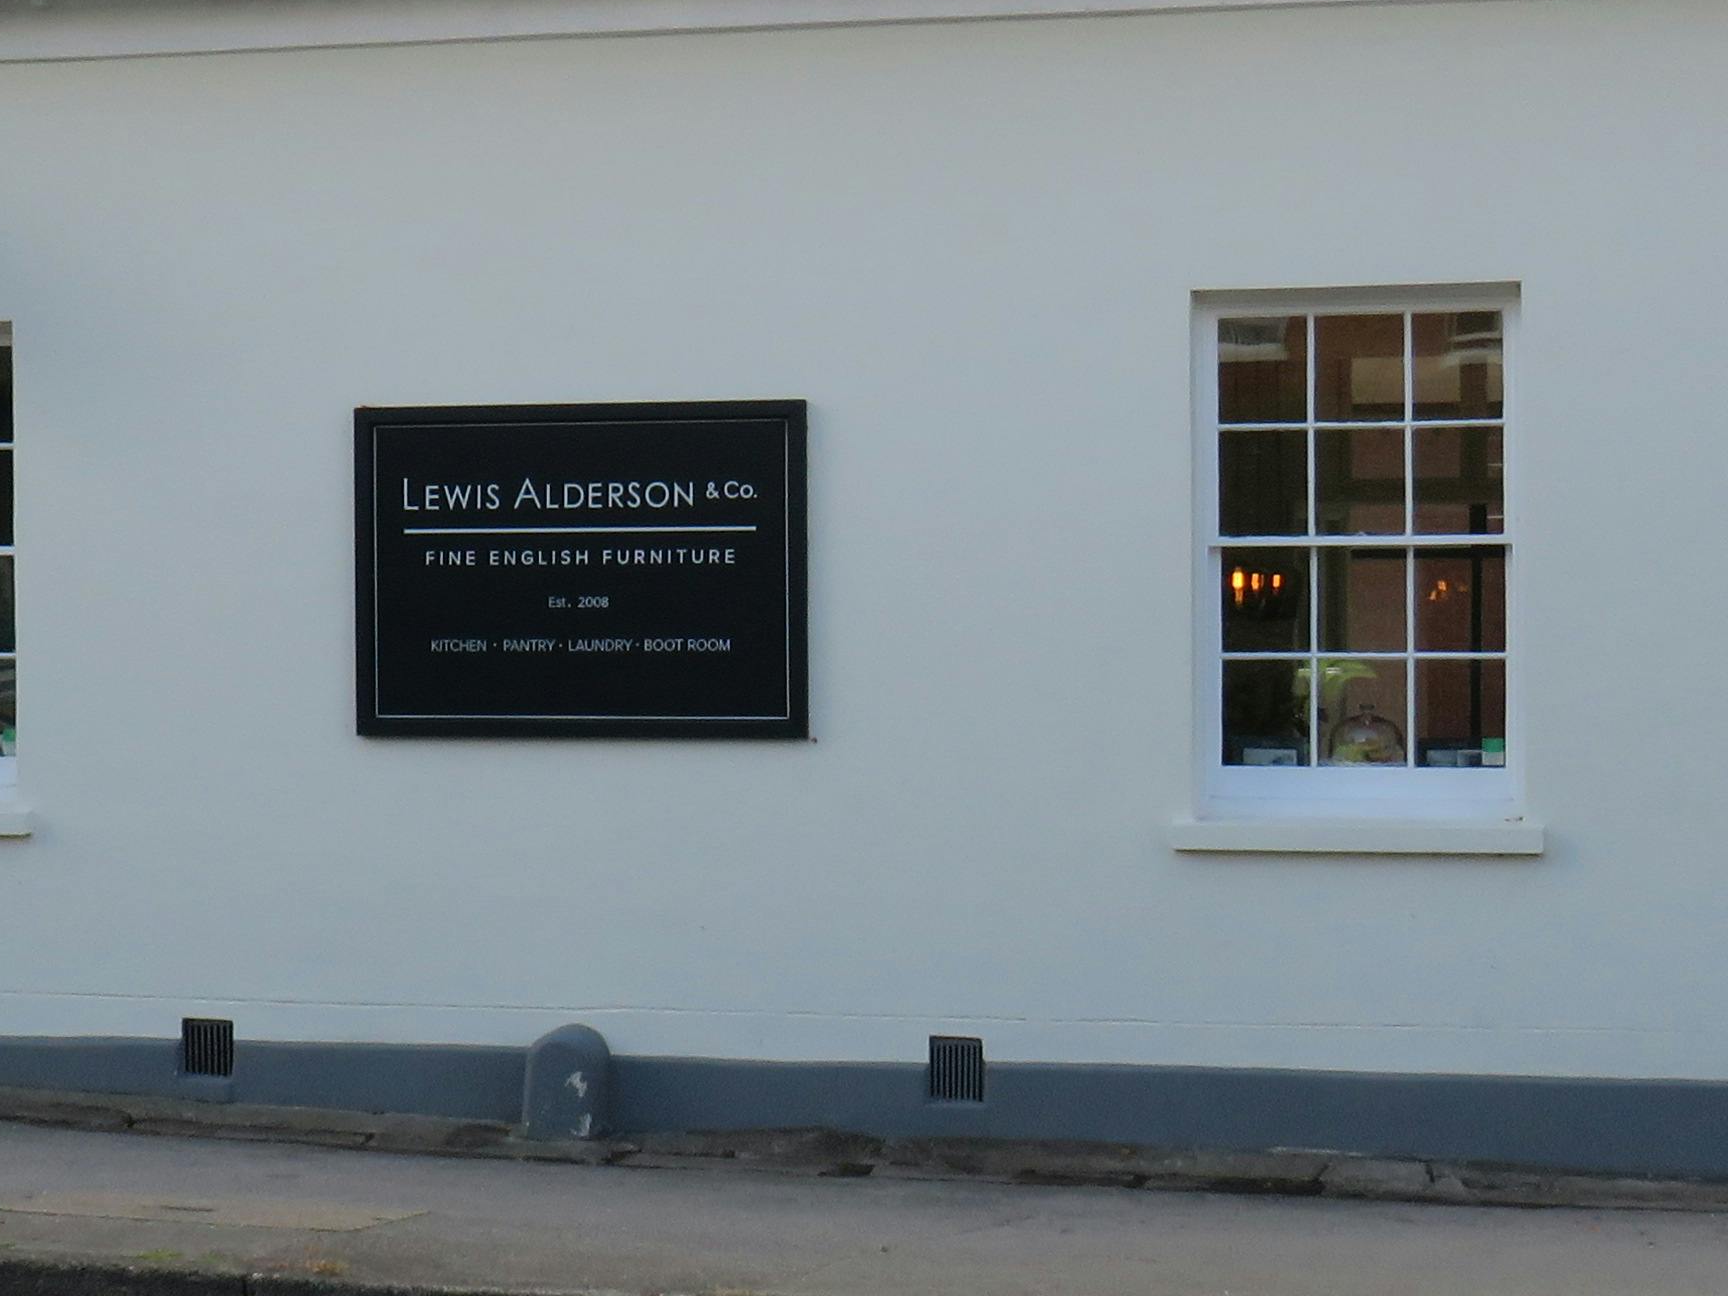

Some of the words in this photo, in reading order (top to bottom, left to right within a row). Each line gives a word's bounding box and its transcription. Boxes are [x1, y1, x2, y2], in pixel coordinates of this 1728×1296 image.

[403, 477, 501, 511] LEWIS
[514, 477, 694, 511] ALDERSON
[425, 550, 476, 566] FINE
[489, 549, 589, 565] ENGLISH
[602, 548, 736, 565] FURNITURE
[547, 596, 572, 609] Est.
[577, 596, 609, 609] 2008
[430, 639, 487, 652] KITCHEN
[503, 639, 556, 652] PANTRY
[568, 639, 633, 652] LAUNDRY
[644, 638, 684, 652] BOOT
[687, 638, 731, 652] ROOM
